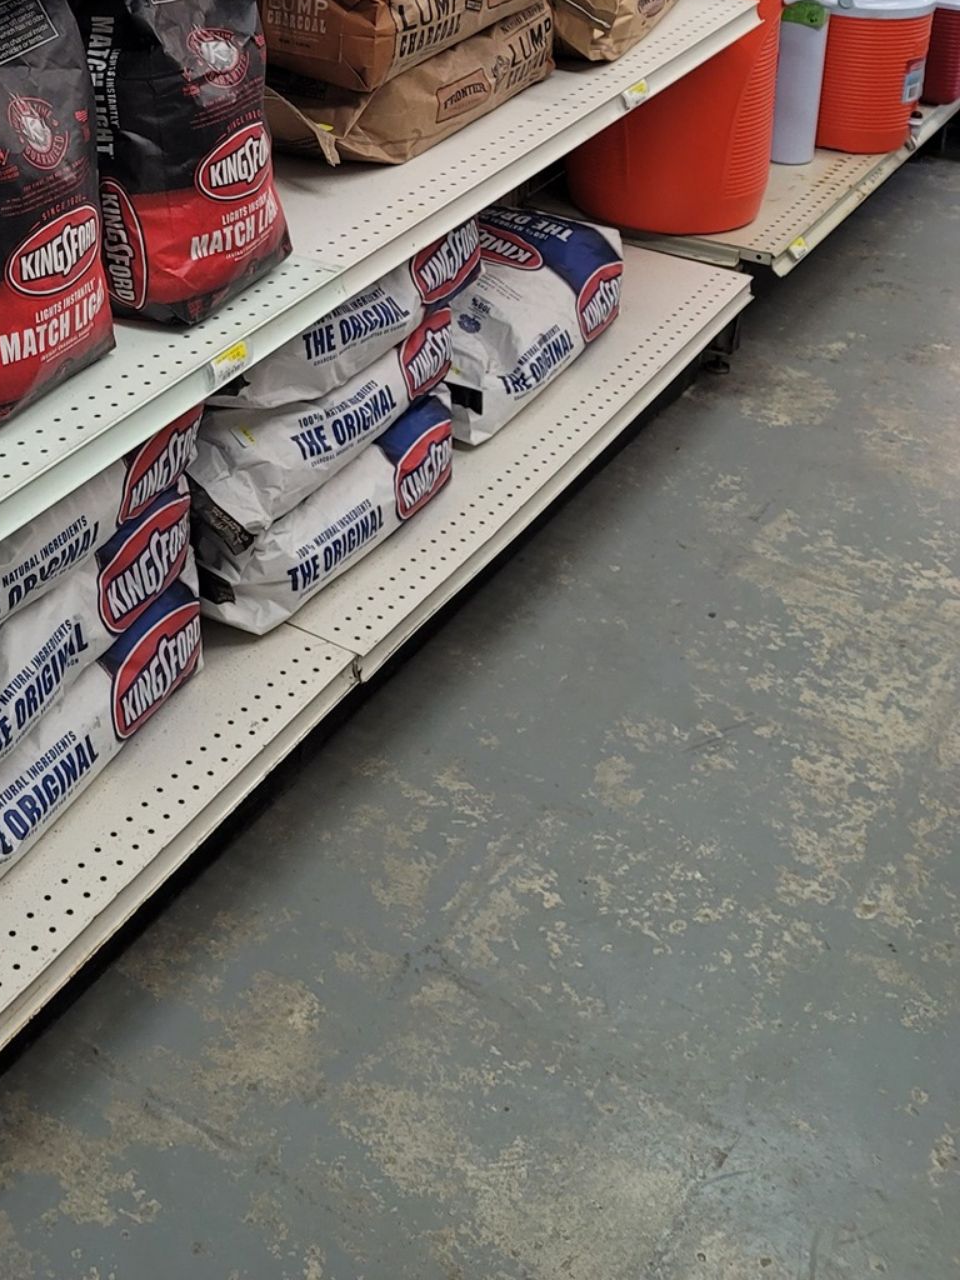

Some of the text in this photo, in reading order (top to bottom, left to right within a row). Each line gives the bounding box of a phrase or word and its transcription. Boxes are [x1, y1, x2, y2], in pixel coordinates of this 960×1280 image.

[266, 13, 327, 35] CHARCOAL
[399, 14, 462, 59] CHARCOAL
[510, 17, 552, 67] LUMP
[443, 81, 487, 110] FRONTIER
[210, 132, 270, 187] KINGSFO
[191, 217, 255, 261] MATCH
[222, 205, 248, 226] LIGHTS
[537, 217, 574, 242] THE
[21, 218, 97, 281] KINGSFORD
[102, 192, 135, 302] KINGSFORD
[0, 278, 104, 366] MATCH LIGH
[35, 277, 97, 323] LIGHTS INSTANTLY
[302, 295, 411, 360] THE ORIGINAL
[532, 329, 576, 383] ORIGINAL
[290, 384, 397, 460] THE ORIGINAL
[1, 556, 40, 589] NATURAL
[39, 515, 88, 561] INGREDIENTS
[287, 503, 385, 592] THE ORIGINAL
[31, 619, 73, 671] INGREDIENTS
[122, 616, 201, 727] KINGSFORD
[26, 730, 78, 781] INGREDIENTS
[3, 734, 100, 841] ORIGINAL
